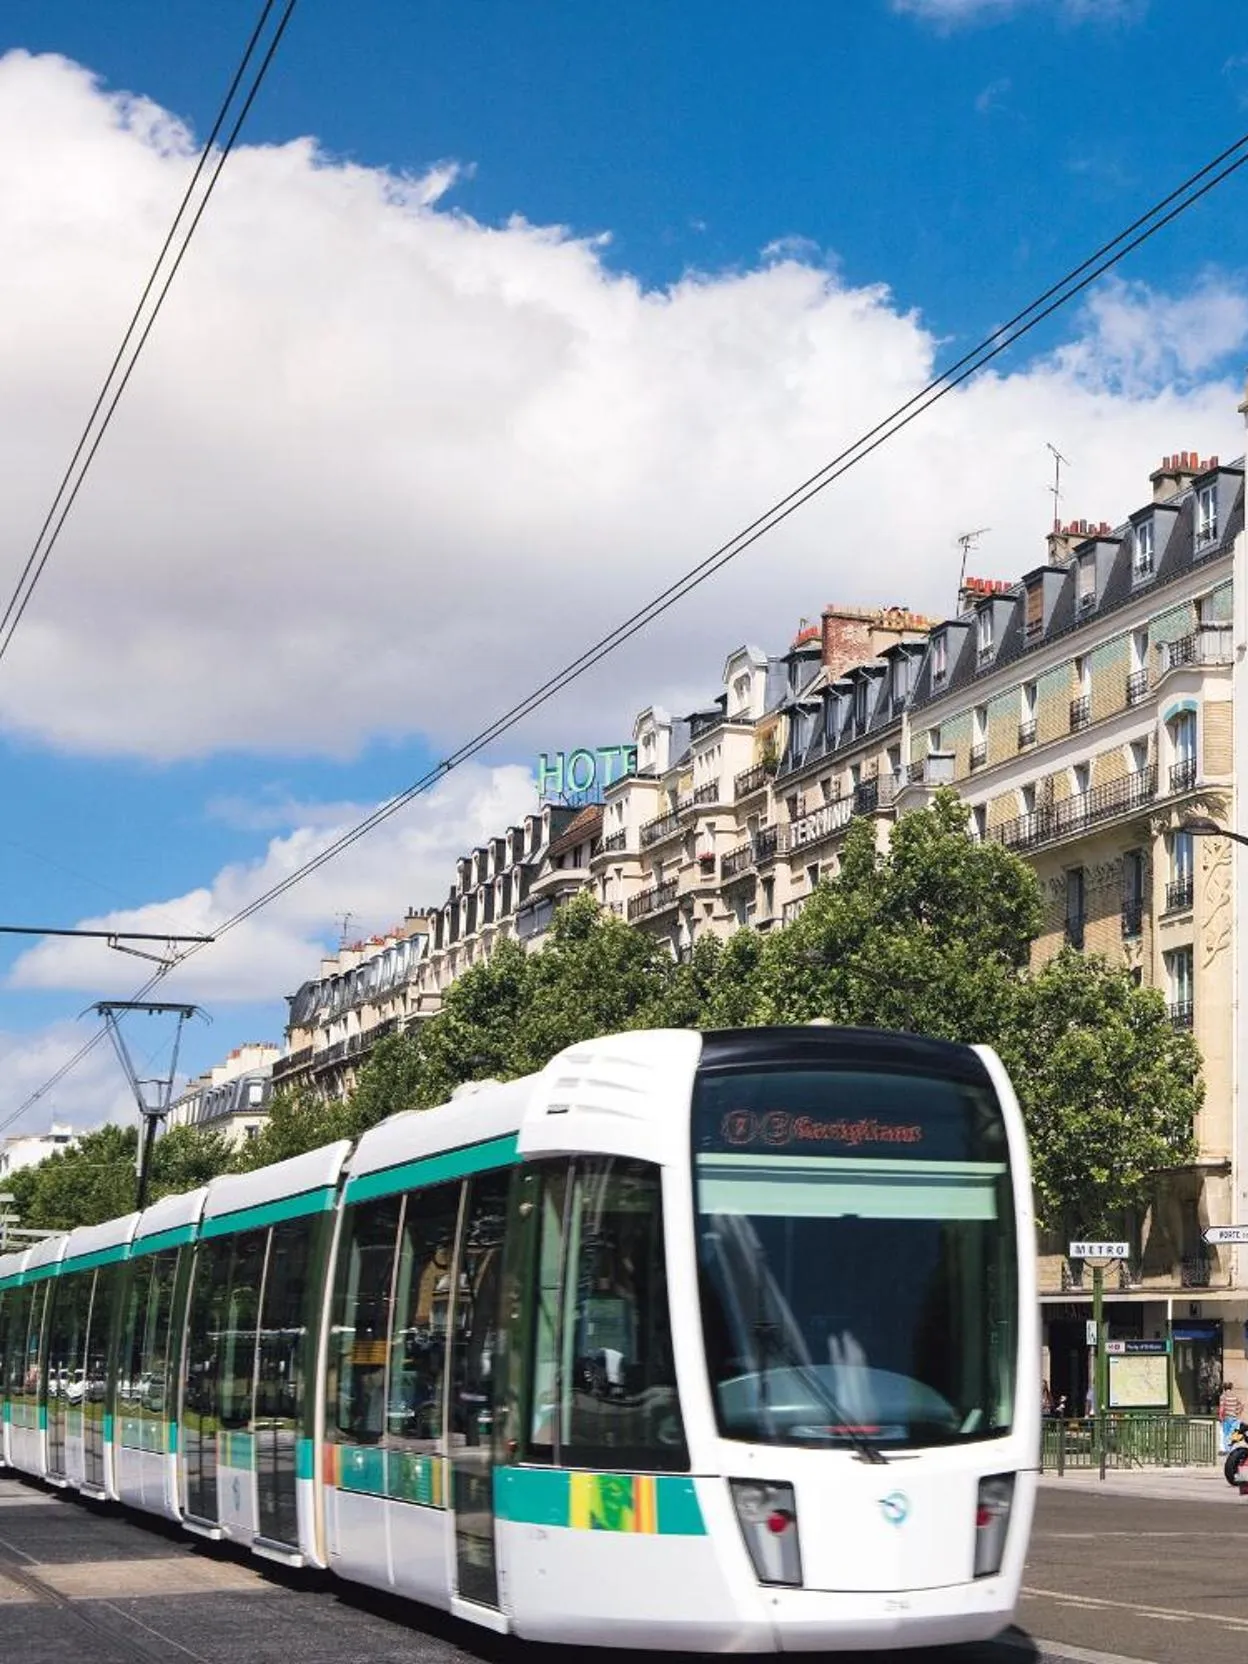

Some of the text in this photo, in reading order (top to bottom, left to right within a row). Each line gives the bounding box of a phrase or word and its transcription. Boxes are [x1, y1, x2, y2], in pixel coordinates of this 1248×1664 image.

[538, 745, 637, 793] HOTE
[791, 797, 853, 847] TERMINU
[1075, 1245, 1124, 1255] METRO
